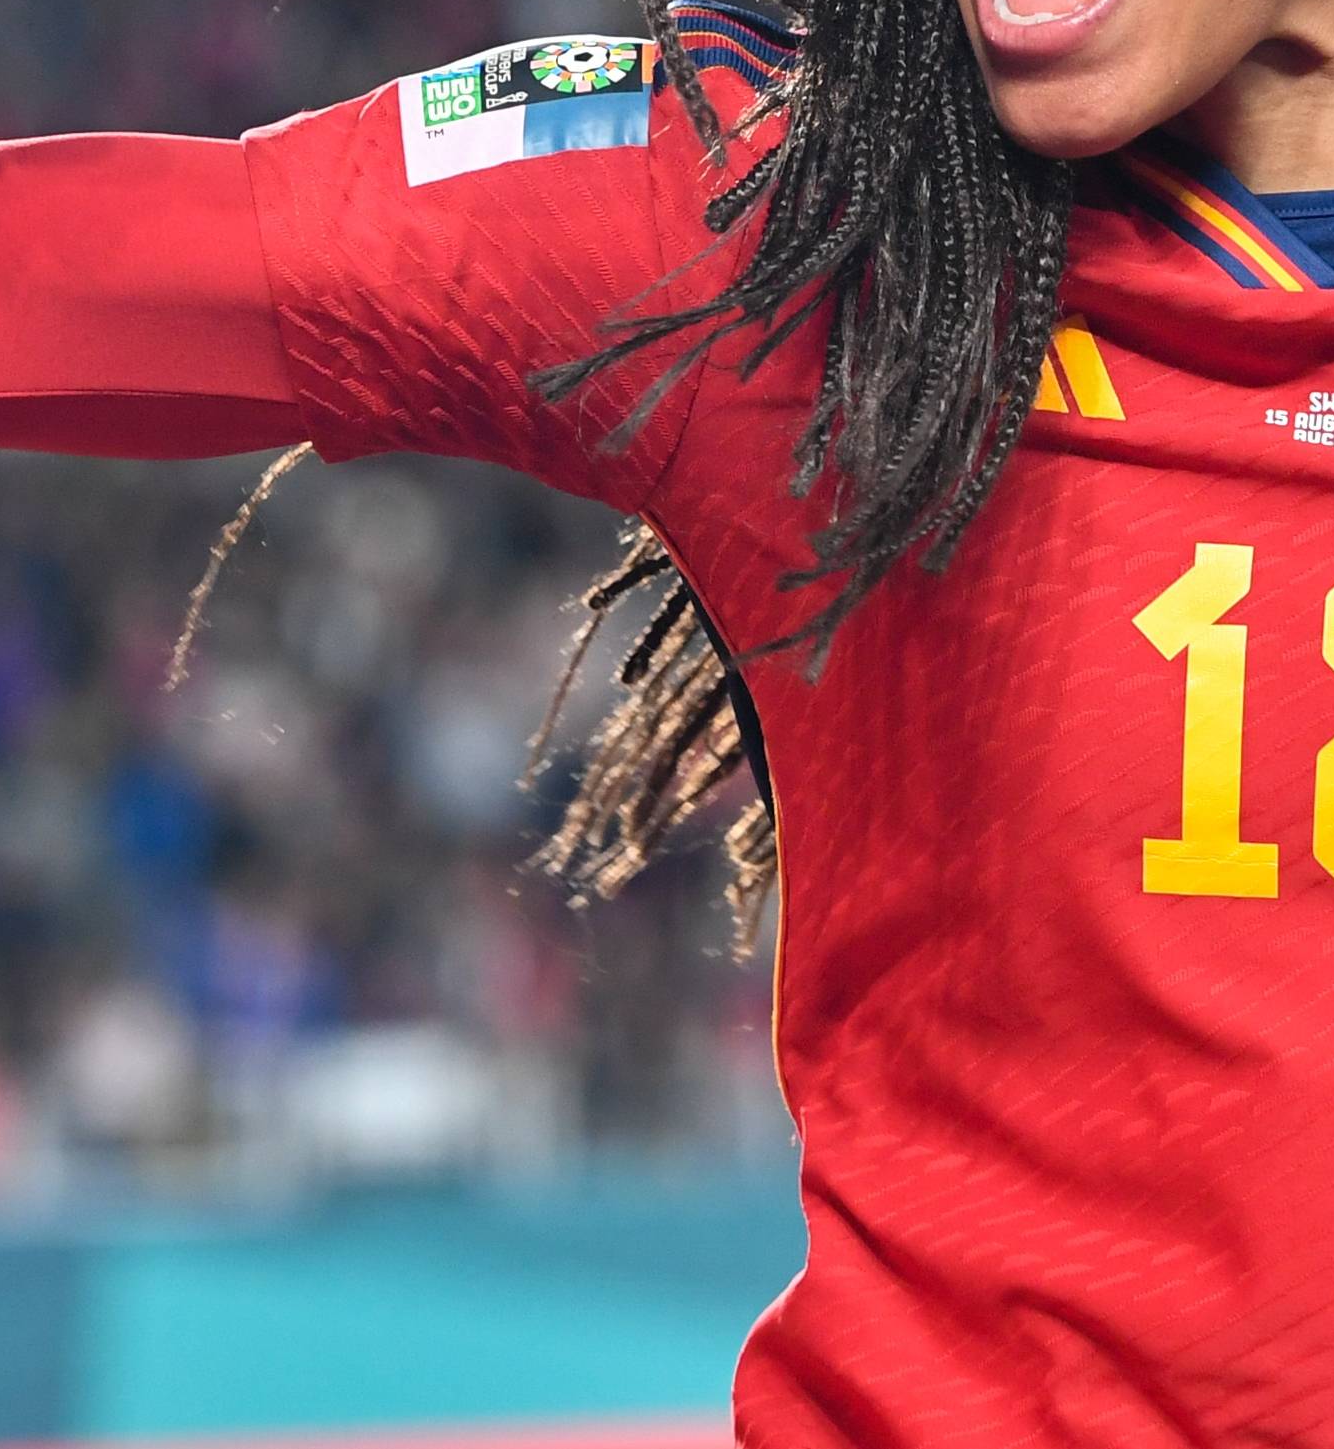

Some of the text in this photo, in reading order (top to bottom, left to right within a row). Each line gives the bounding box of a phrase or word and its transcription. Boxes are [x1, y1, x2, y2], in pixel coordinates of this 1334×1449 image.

[426, 81, 452, 122] 23
[451, 77, 476, 116] 20
[425, 129, 445, 140] TM
[1264, 409, 1288, 426] 15
